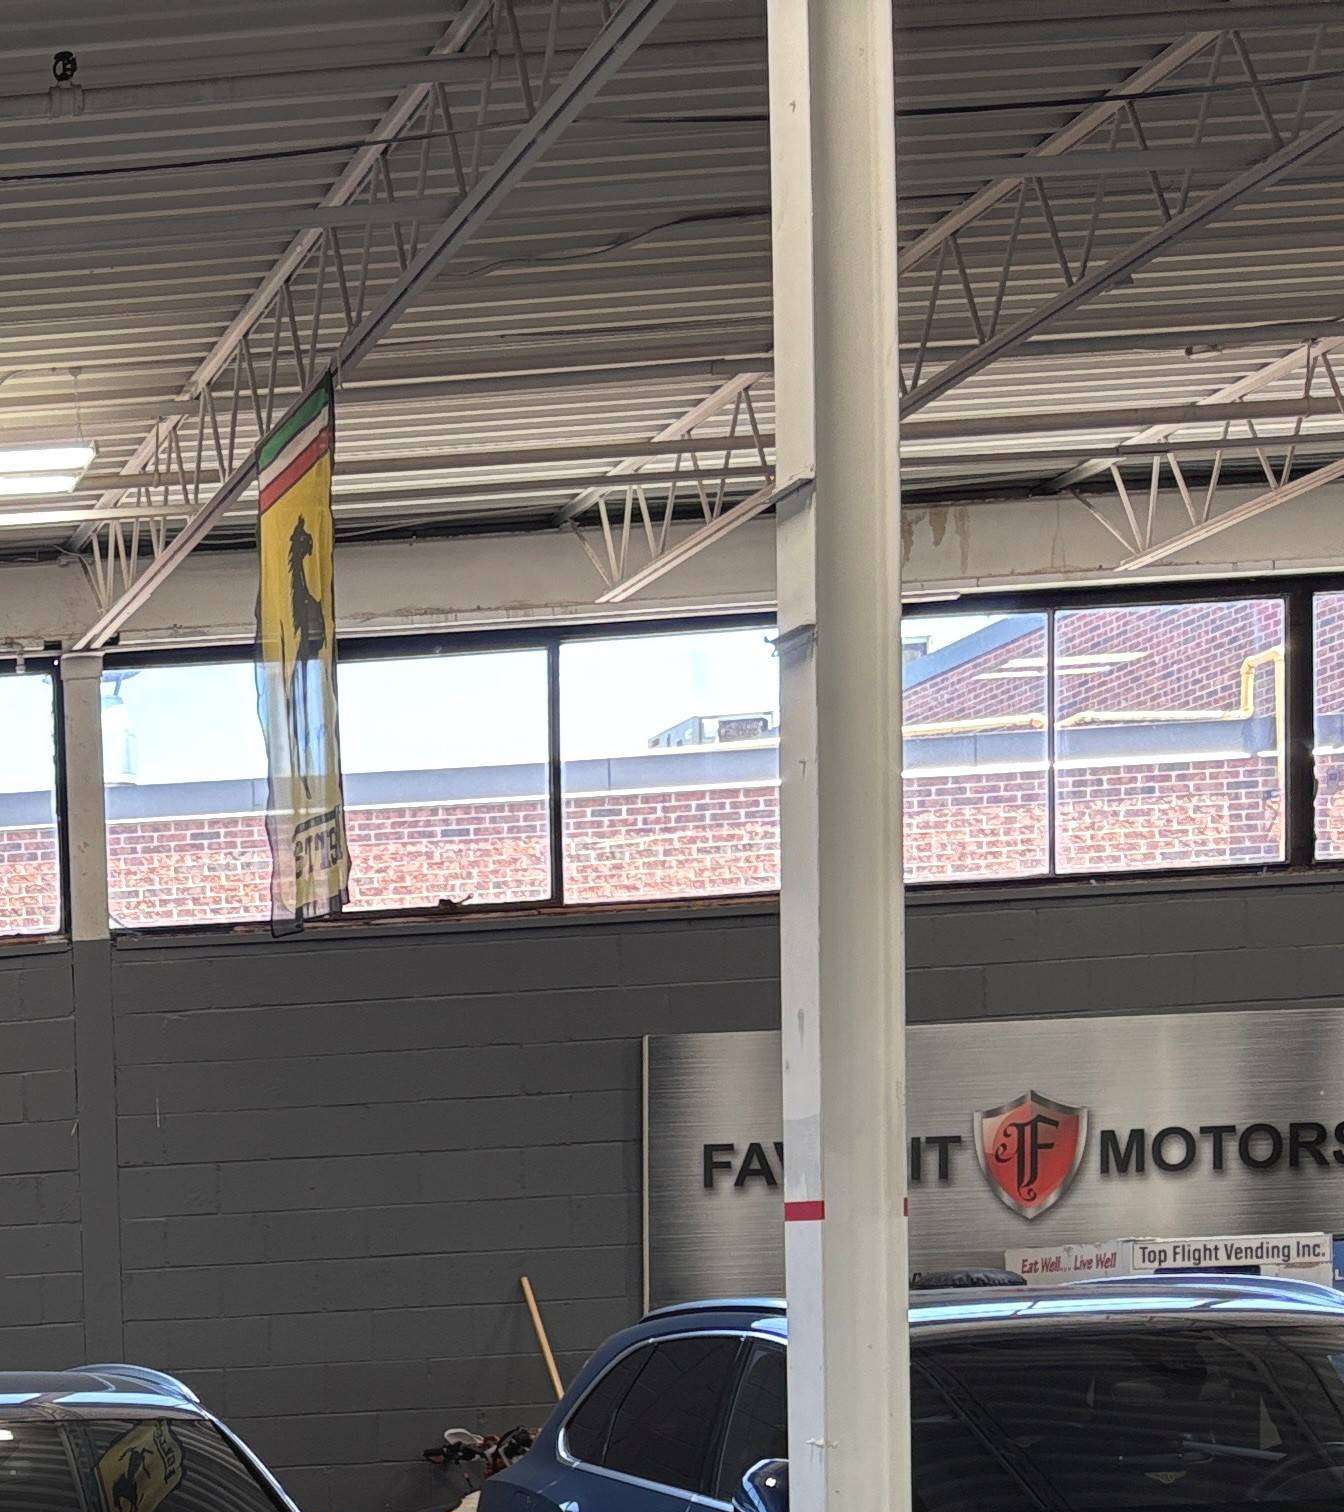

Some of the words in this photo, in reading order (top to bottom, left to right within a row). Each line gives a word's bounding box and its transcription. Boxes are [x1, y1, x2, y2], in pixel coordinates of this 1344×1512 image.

[703, 1136, 961, 1188] FAIT
[1021, 1258, 1040, 1275] Eat
[1073, 1254, 1094, 1271] Live
[1095, 1251, 1117, 1270] Well
[1139, 1246, 1168, 1266] Top
[1172, 1244, 1220, 1266] Flight
[1223, 1241, 1291, 1262] Vending
[1296, 1240, 1326, 1258] Inc.
